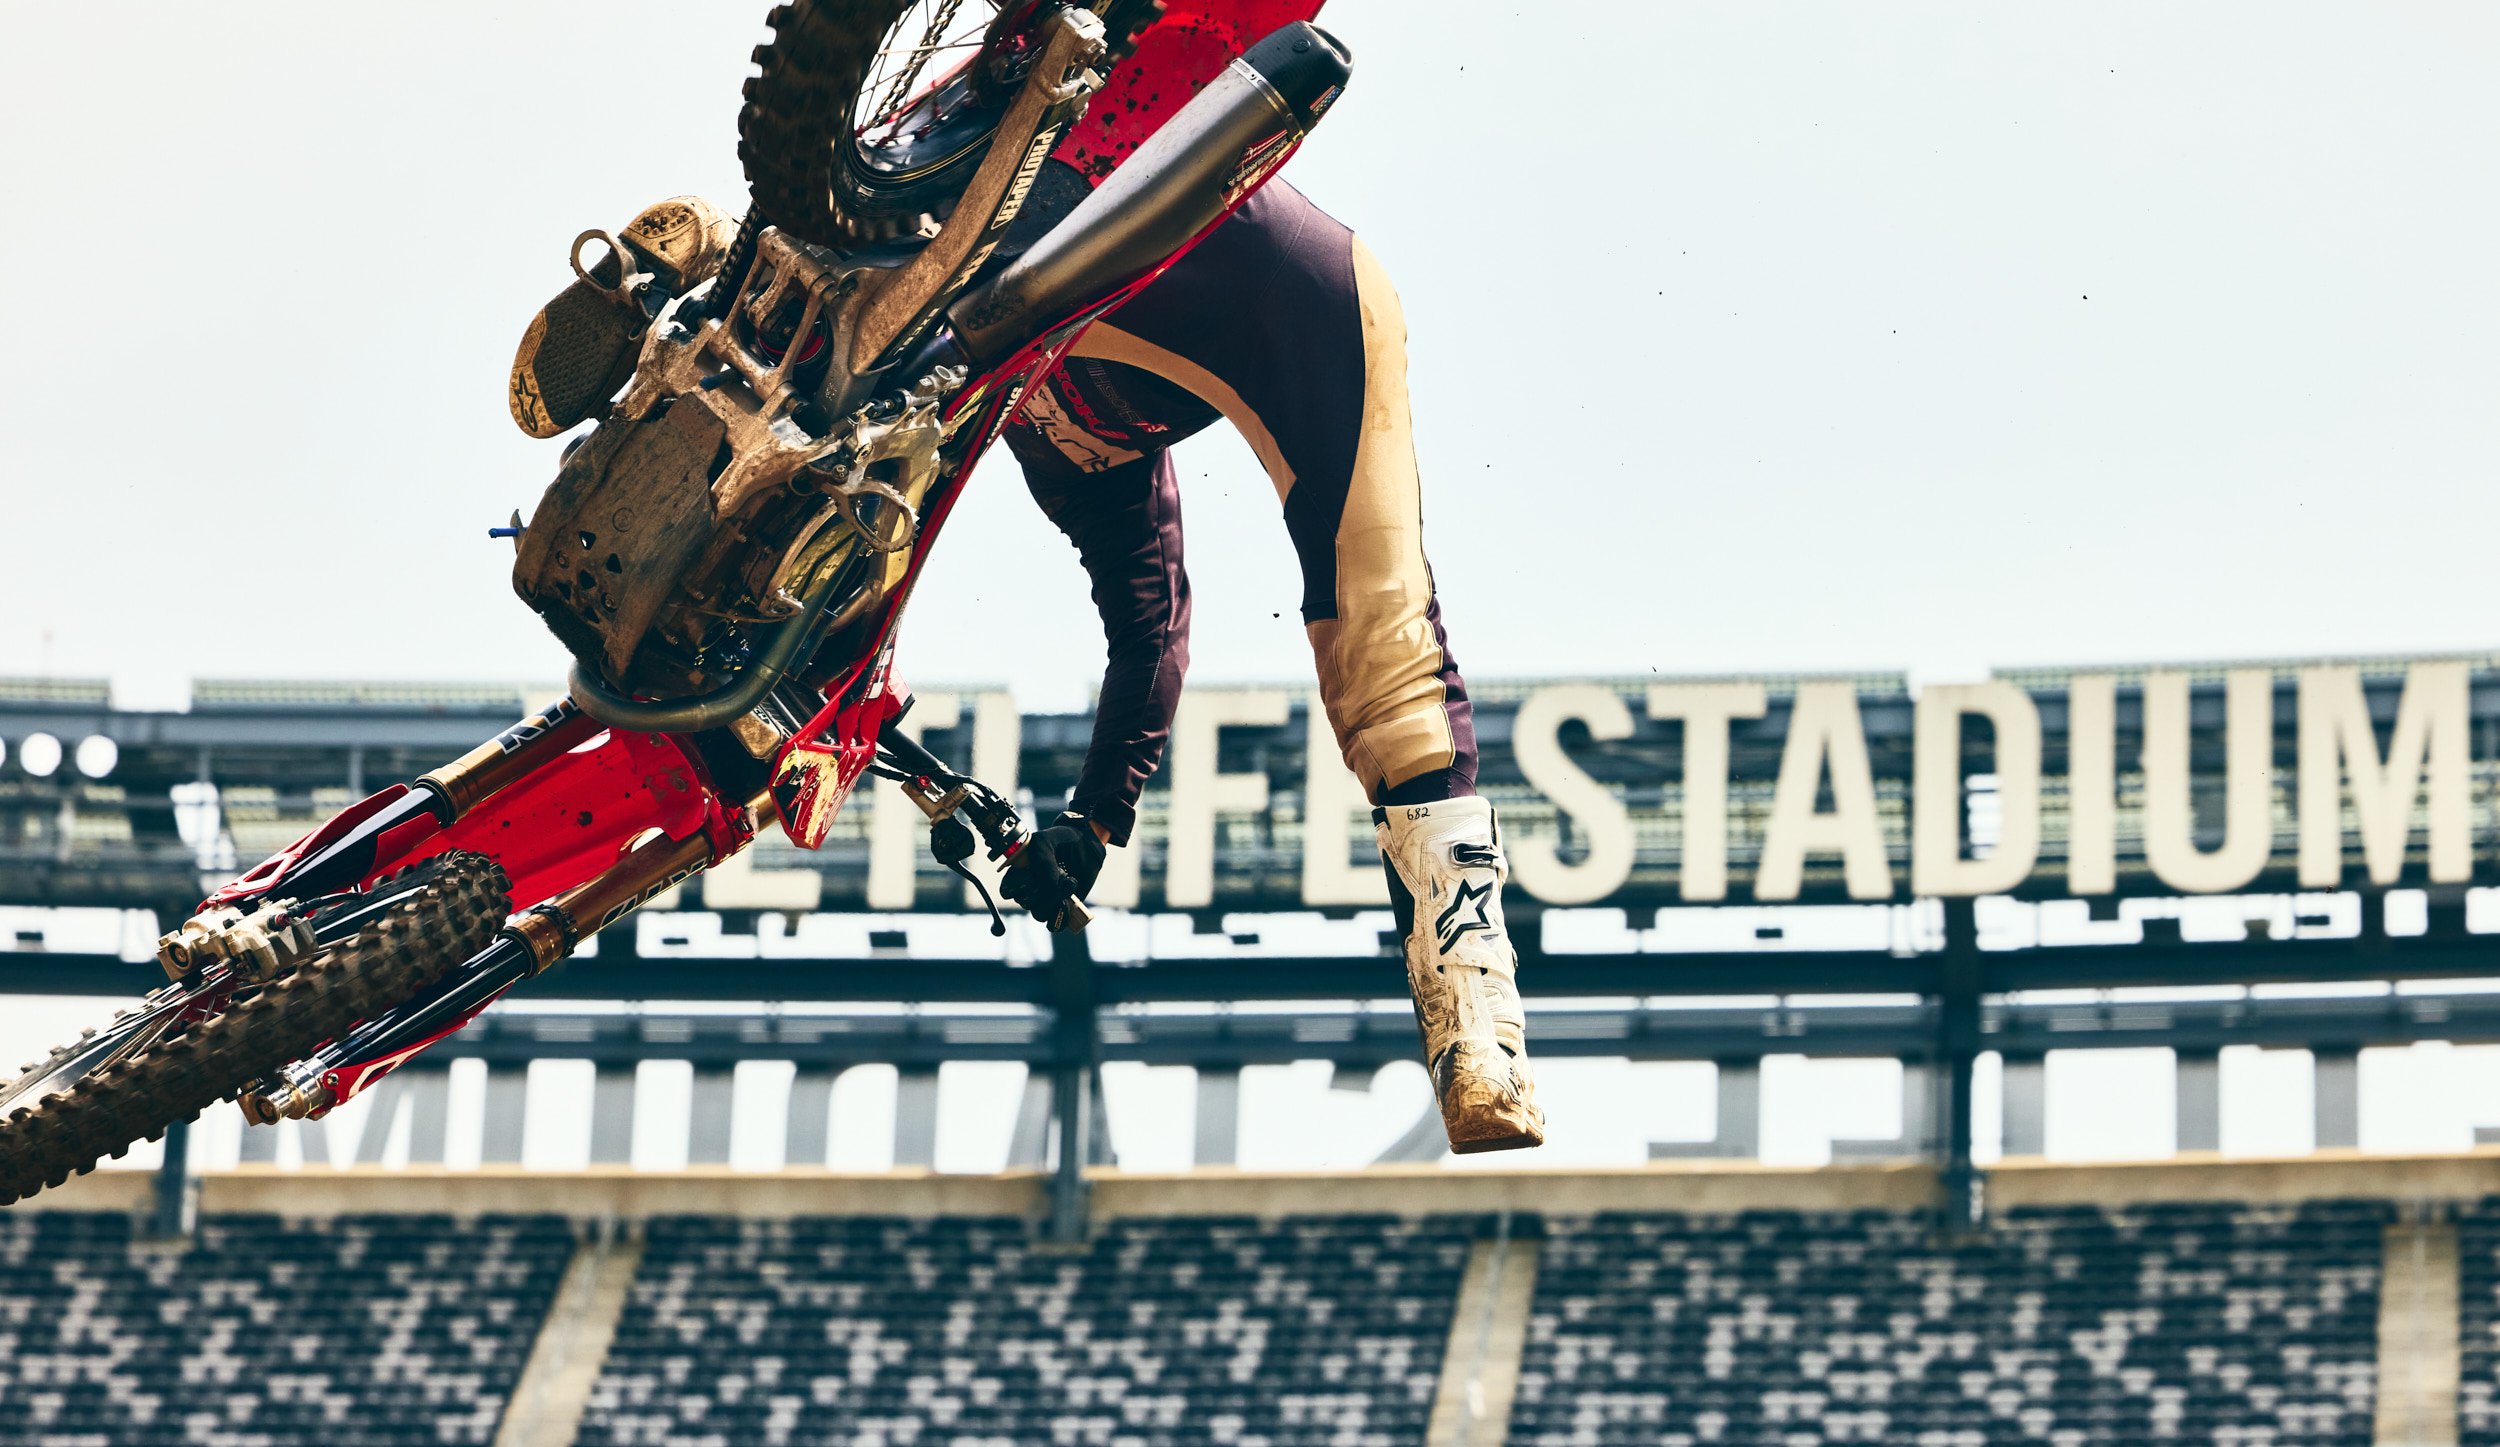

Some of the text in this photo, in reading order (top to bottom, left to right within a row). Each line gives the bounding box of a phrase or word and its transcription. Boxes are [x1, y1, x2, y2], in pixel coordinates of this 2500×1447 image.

[993, 131, 1057, 227] PROTAPER
[943, 240, 999, 295] RK
[1407, 807, 1431, 820] 682
[1512, 661, 2473, 905] STADIUM
